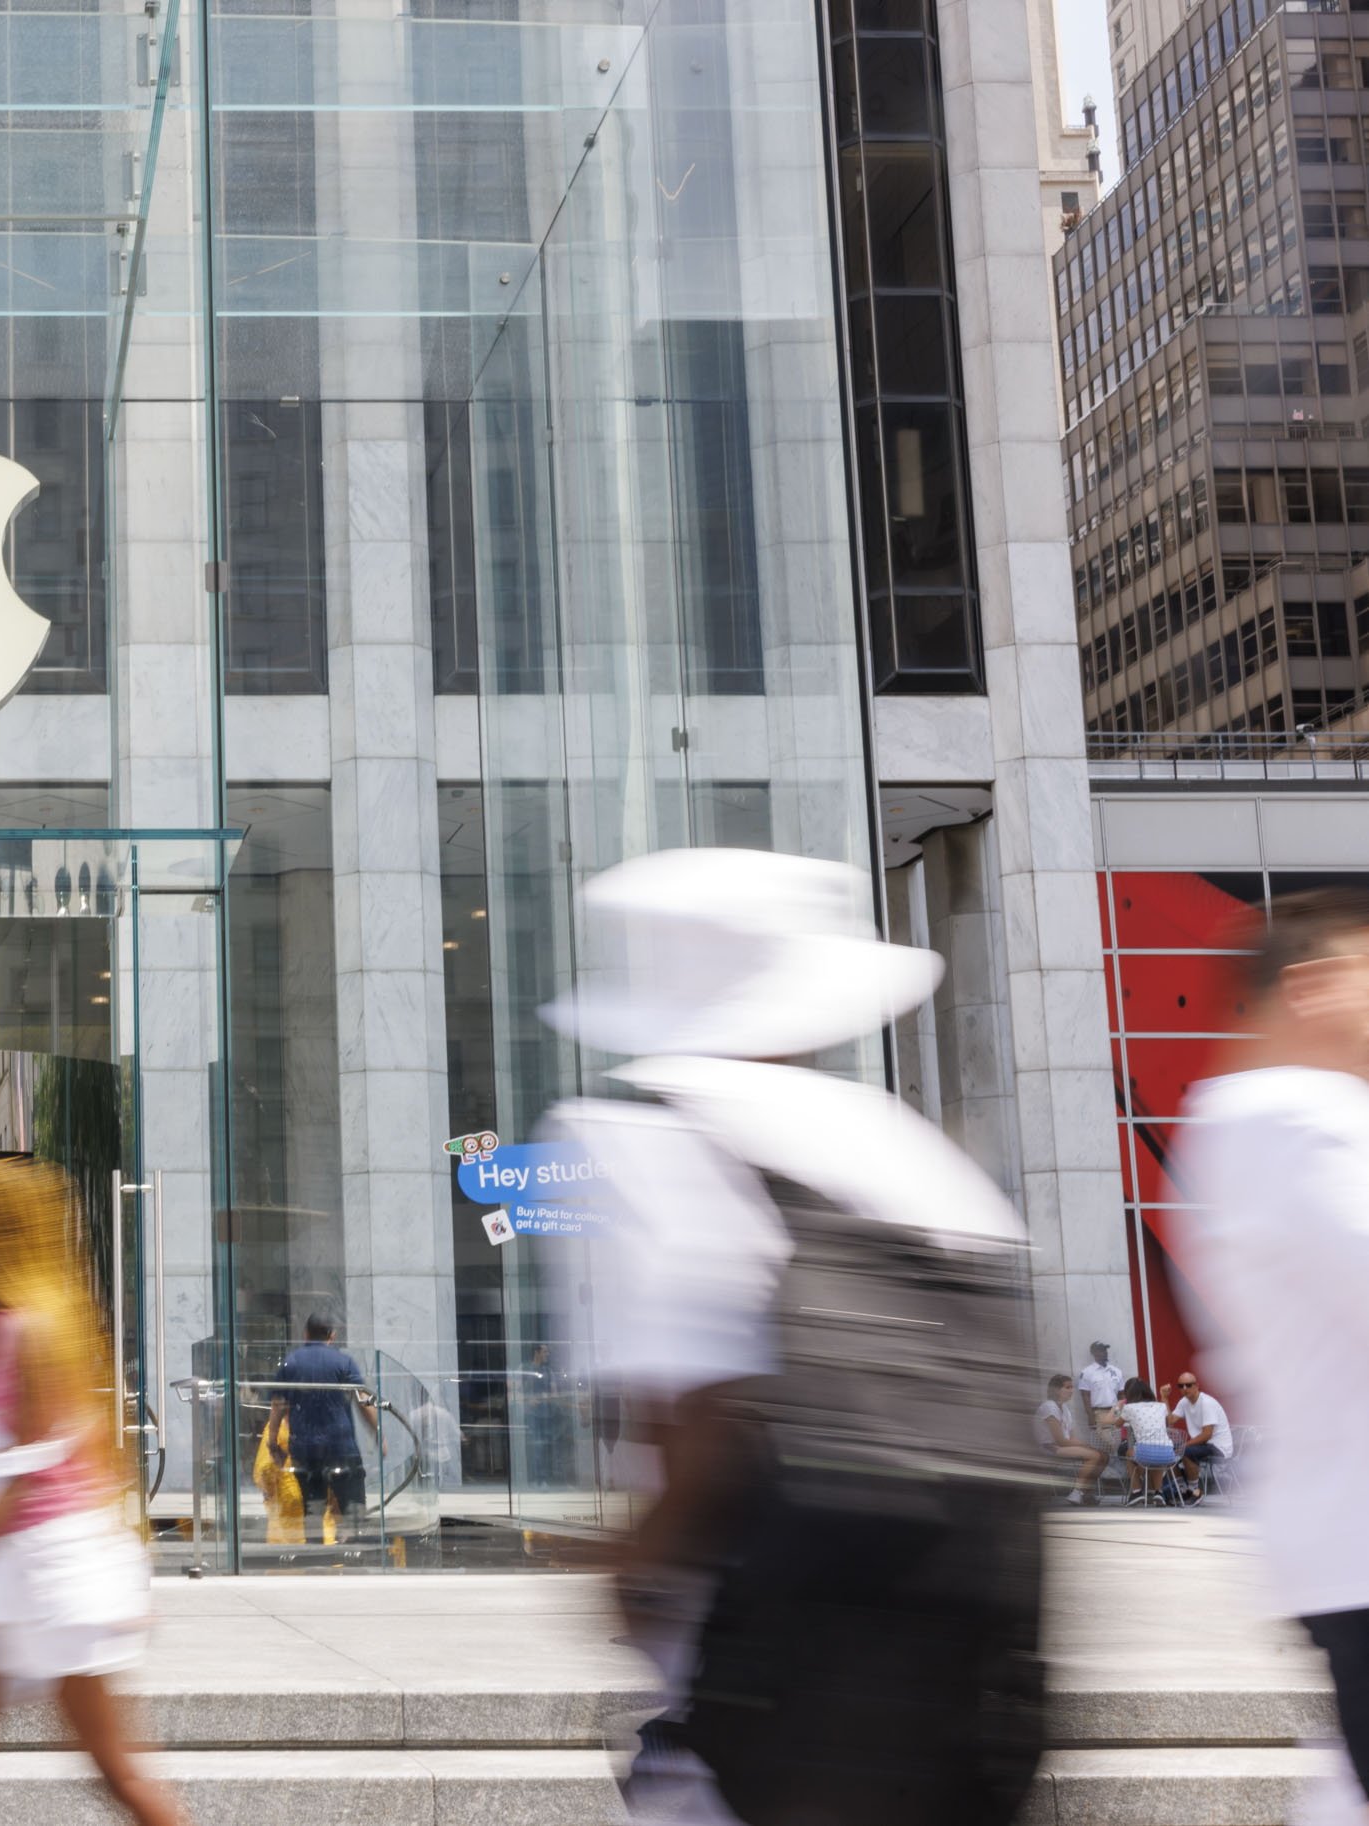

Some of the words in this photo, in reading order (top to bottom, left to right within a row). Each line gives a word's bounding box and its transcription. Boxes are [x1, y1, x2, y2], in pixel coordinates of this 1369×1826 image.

[478, 1164, 529, 1190] Hey
[536, 1158, 616, 1184] stude
[516, 1206, 535, 1218] Buy
[537, 1208, 559, 1218] iPad
[560, 1210, 574, 1220] for
[516, 1219, 532, 1230] get
[542, 1220, 559, 1232] gift
[560, 1223, 582, 1232] card
